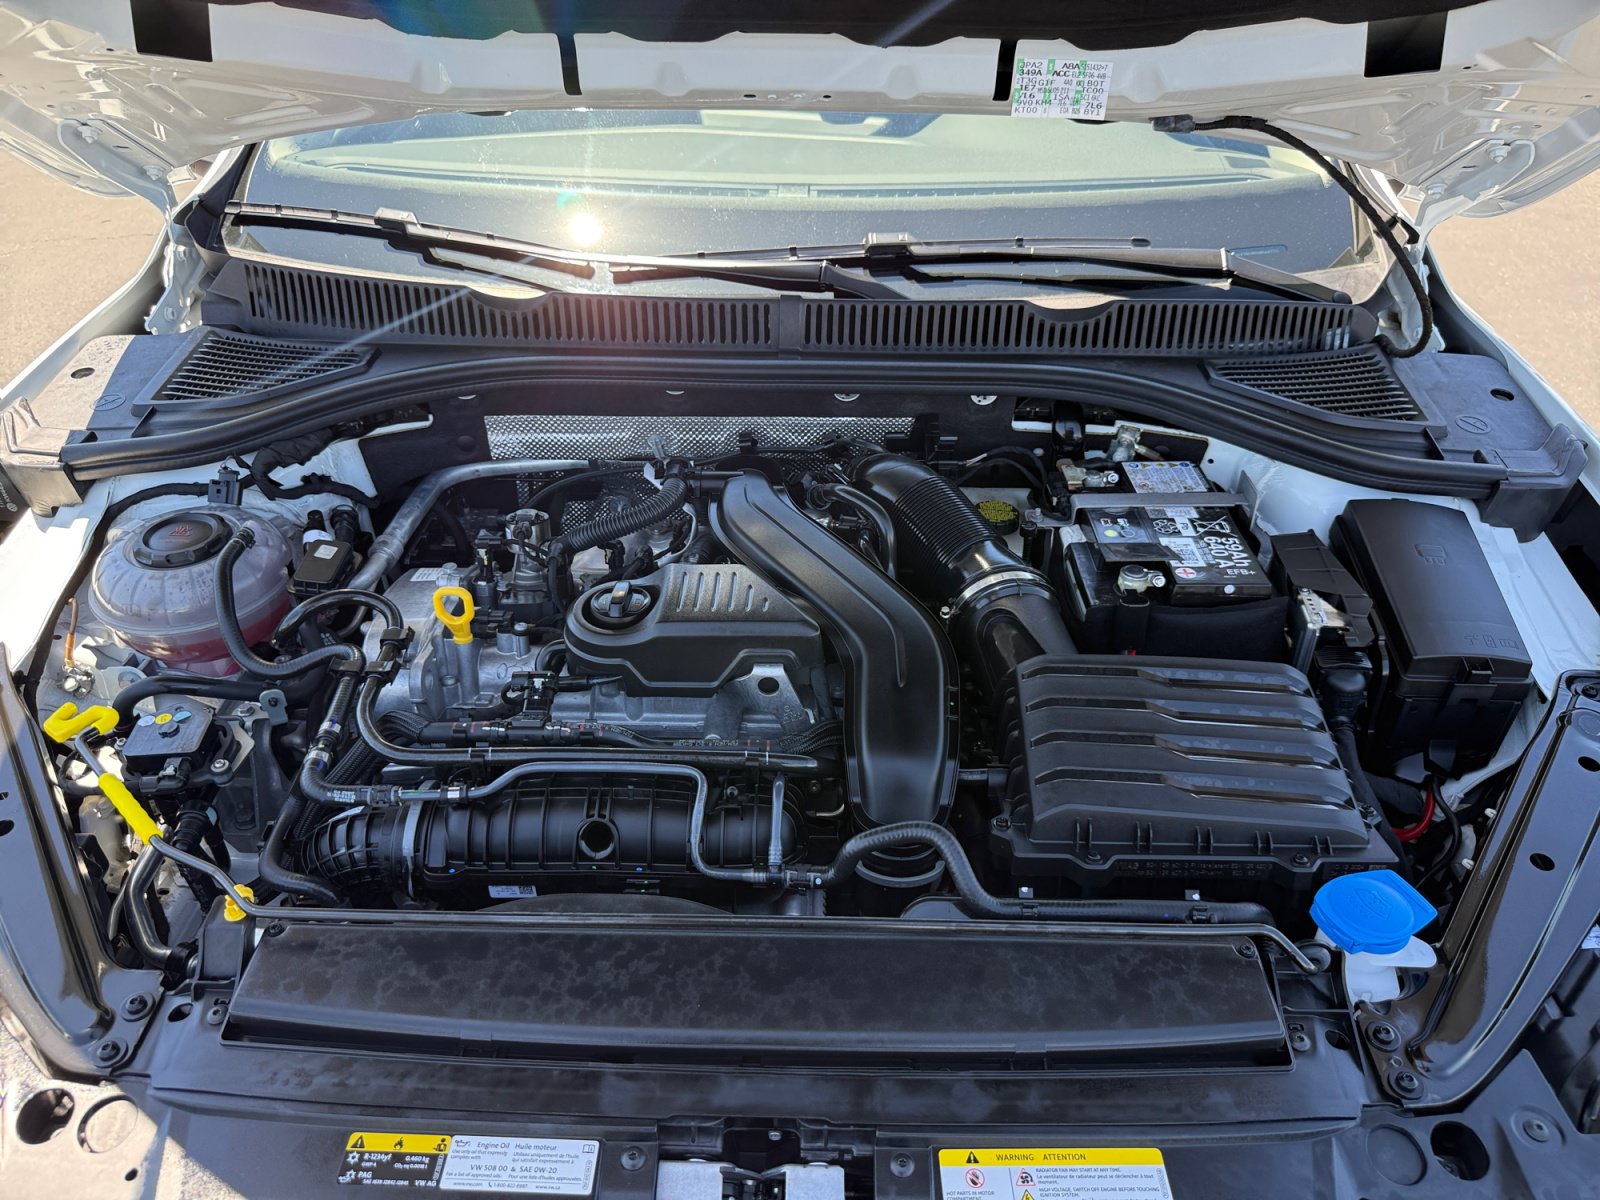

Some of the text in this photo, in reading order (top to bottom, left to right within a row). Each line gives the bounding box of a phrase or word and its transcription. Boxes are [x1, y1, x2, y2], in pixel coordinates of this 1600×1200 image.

[1203, 536, 1228, 557] 640
[1218, 559, 1233, 568] A
[1222, 537, 1250, 567] 59Ah
[477, 1141, 499, 1149] Engine
[363, 1153, 392, 1162] R-1234yf
[357, 1171, 373, 1179] PAG
